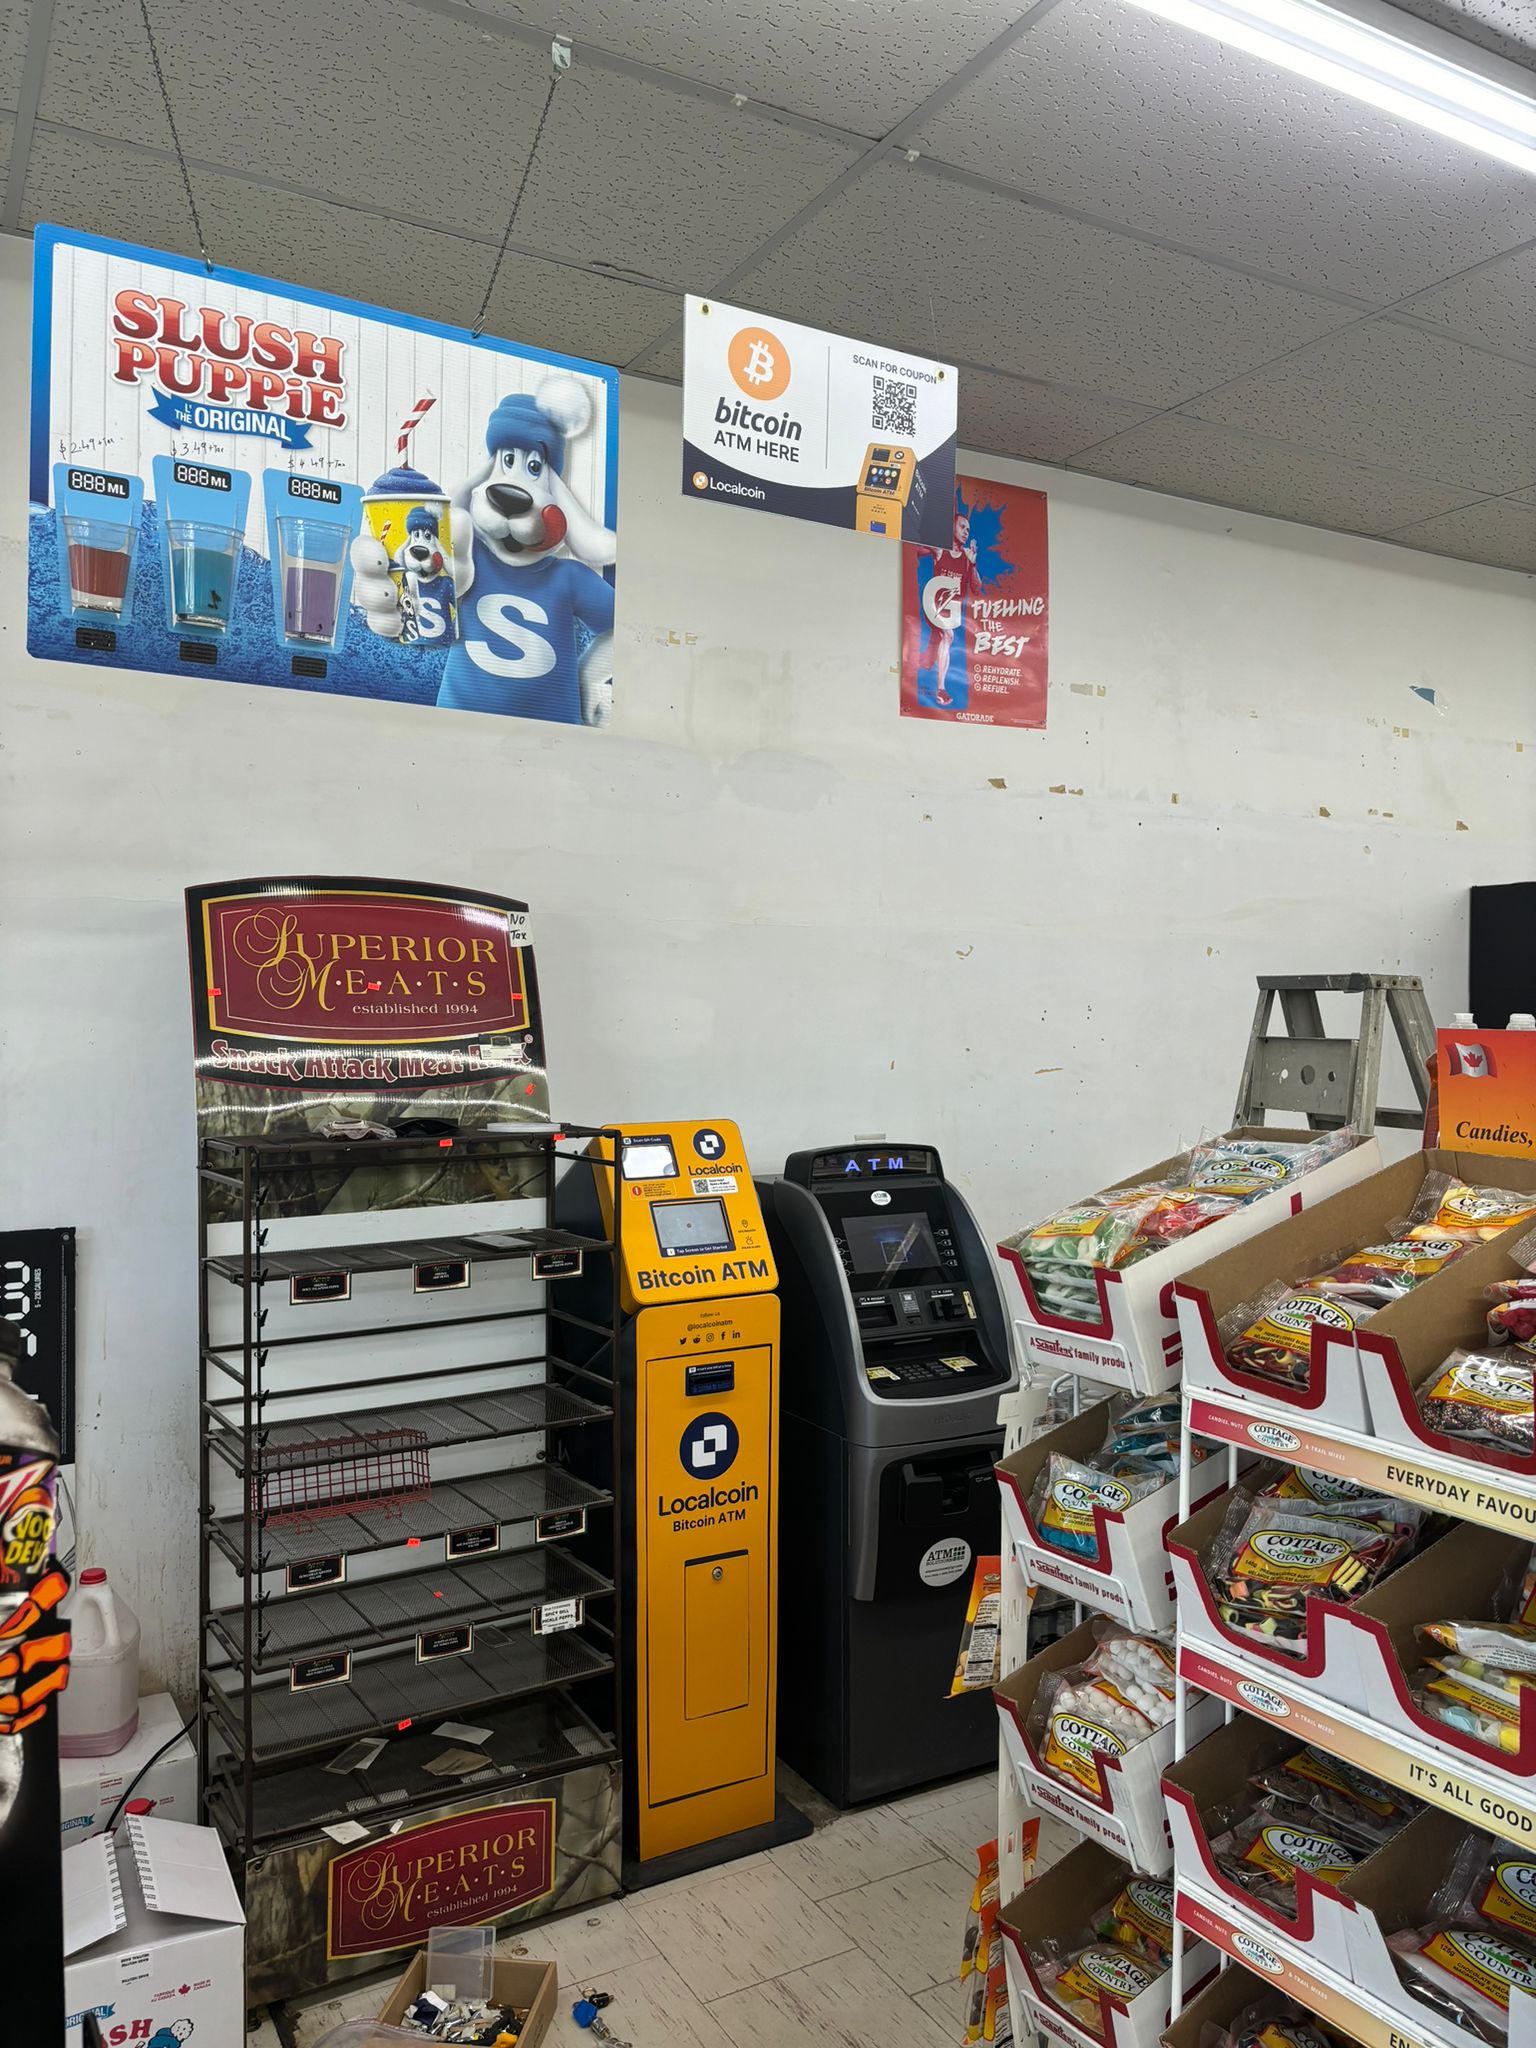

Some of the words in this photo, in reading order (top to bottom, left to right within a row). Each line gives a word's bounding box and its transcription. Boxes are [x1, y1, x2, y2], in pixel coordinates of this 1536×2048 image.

[114, 290, 346, 385] SLUSH
[853, 354, 878, 370] SCAN
[880, 361, 898, 375] FOR
[899, 366, 937, 385] COUPON
[174, 409, 193, 425] THE
[194, 405, 293, 442] ORIGINAL
[714, 396, 802, 441] bitcoin
[714, 430, 751, 453] ATM
[756, 438, 800, 463] HERE
[72, 471, 105, 493] 888
[107, 482, 126, 496] ML
[177, 465, 209, 487] 888
[210, 475, 229, 489] ML
[710, 476, 765, 500] Localcoin
[291, 478, 321, 499] 888
[322, 489, 339, 502] ML
[971, 597, 1045, 619] FUELLING
[464, 594, 557, 679] S
[980, 619, 1004, 632] THE
[973, 632, 1030, 658] BEST
[956, 713, 995, 723] GATORADE
[510, 913, 526, 925] NO
[233, 907, 499, 968] SUPERIOR
[511, 929, 527, 940] Tax
[352, 1003, 438, 1015] established
[446, 1003, 479, 1015] 1994
[211, 1039, 303, 1081] Snack
[399, 1051, 463, 1080] Meat
[1455, 1120, 1533, 1148] Candies,
[688, 1163, 743, 1176] Localcoin
[637, 1265, 716, 1290] Bitcoin
[722, 1259, 769, 1281] ATM
[687, 1320, 733, 1331] @localcoinatm
[1274, 1313, 1312, 1330] COUNT
[1074, 1348, 1100, 1364] family
[1102, 1356, 1129, 1370] produ
[1254, 1424, 1294, 1444] COTTAGE
[658, 1480, 758, 1517] Localcoin
[1387, 1465, 1470, 1503] EVERYDAY
[1476, 1493, 1536, 1524] FAVOU
[673, 1515, 715, 1532] Bitcoin
[718, 1509, 746, 1524] ATM
[927, 1548, 953, 1561] ATM
[1267, 1535, 1340, 1554] COTTAGE
[1268, 1548, 1324, 1564] COUNTRY
[1074, 1577, 1099, 1595] family
[1219, 1676, 1233, 1686] NUTS
[1243, 1684, 1284, 1709] COTTAGE
[1300, 1714, 1316, 1728] TRAIL
[1410, 1763, 1438, 1788] IT'S
[1443, 1780, 1473, 1806] ALL
[1480, 1798, 1533, 1832] GOOD
[1075, 1809, 1100, 1832] family
[1102, 1827, 1129, 1848] produ
[347, 1826, 537, 1902] SUPERIOR
[426, 1893, 489, 1919] established
[492, 1884, 518, 1900] 1994
[1214, 1923, 1228, 1936] NUTS
[1238, 1935, 1278, 1967] COTTAGE
[1457, 1962, 1491, 1985] CHOCOLATE
[1464, 1942, 1535, 1986] COUNTR
[1087, 1962, 1135, 1992] COUNTRY
[1294, 1974, 1309, 1989] TRAIL
